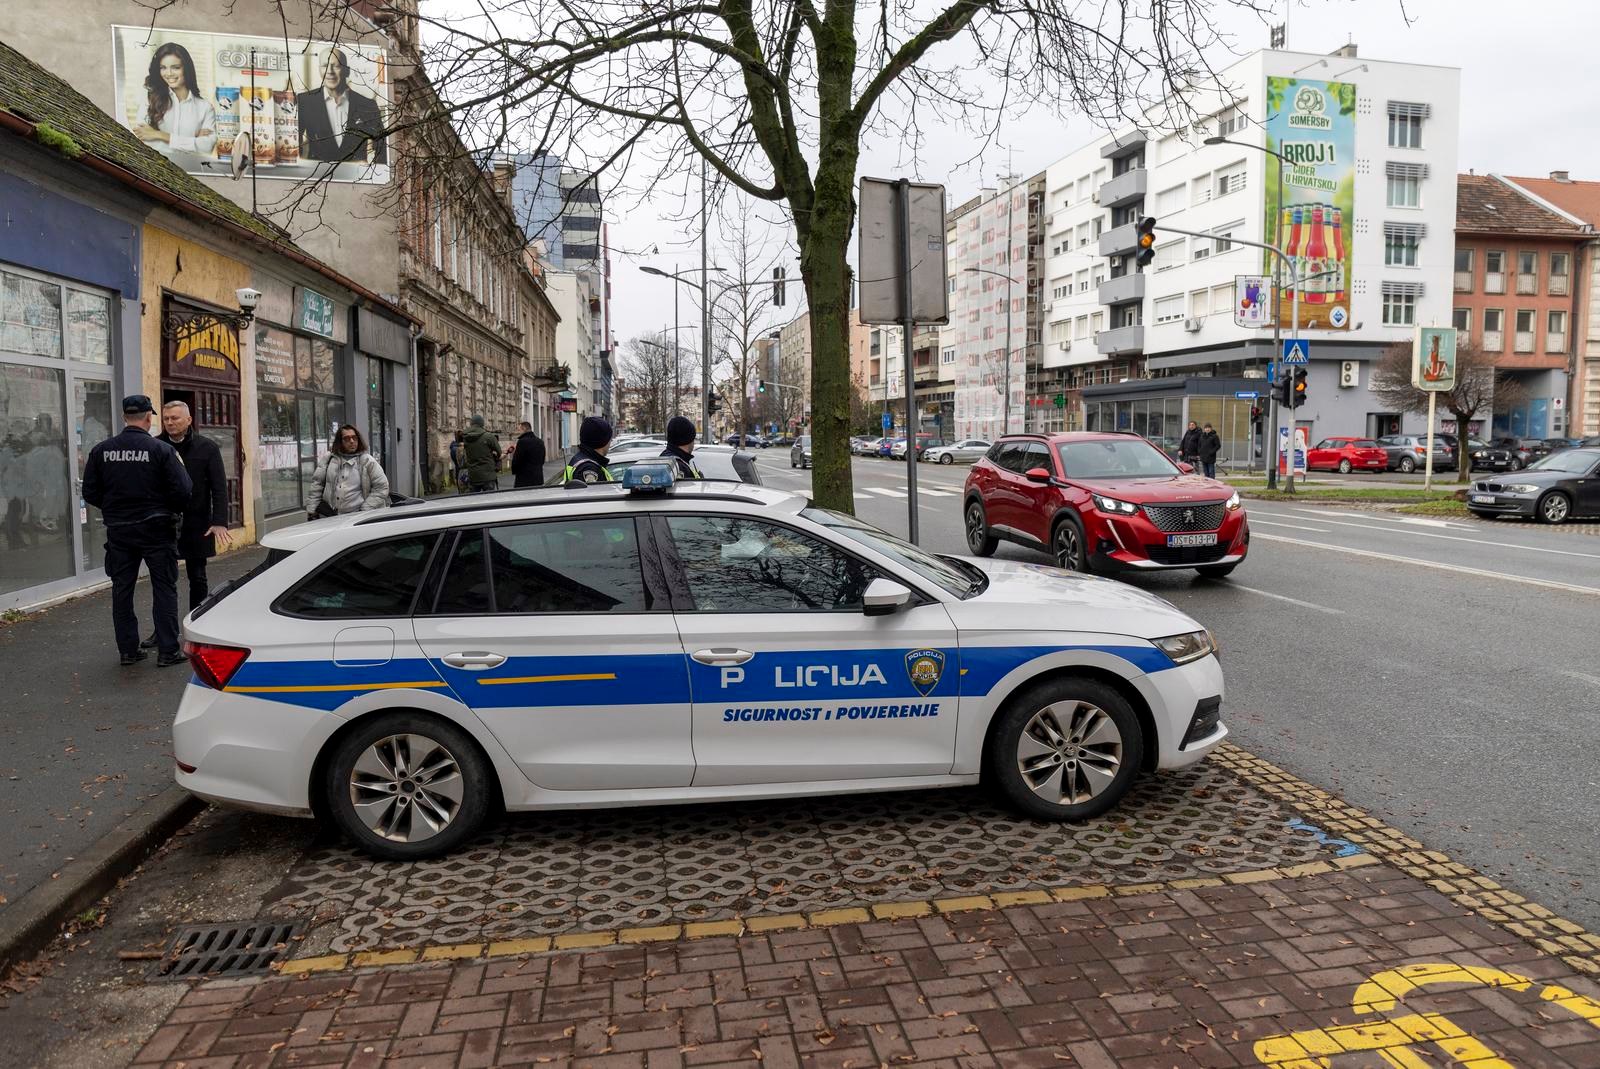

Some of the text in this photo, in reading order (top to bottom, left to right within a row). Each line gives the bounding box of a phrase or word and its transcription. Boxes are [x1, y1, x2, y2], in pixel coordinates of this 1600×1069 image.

[1289, 116, 1330, 127] SOMERSBY
[1284, 143, 1334, 163] BROJ 1
[1285, 174, 1337, 190] U HRVATSKOJ
[103, 450, 150, 463] POLICIJA
[1173, 534, 1217, 546] OS 613-PV
[907, 651, 943, 661] POLICIJA
[723, 706, 823, 722] SIGURNOST
[836, 703, 940, 720] POVJERENJE
